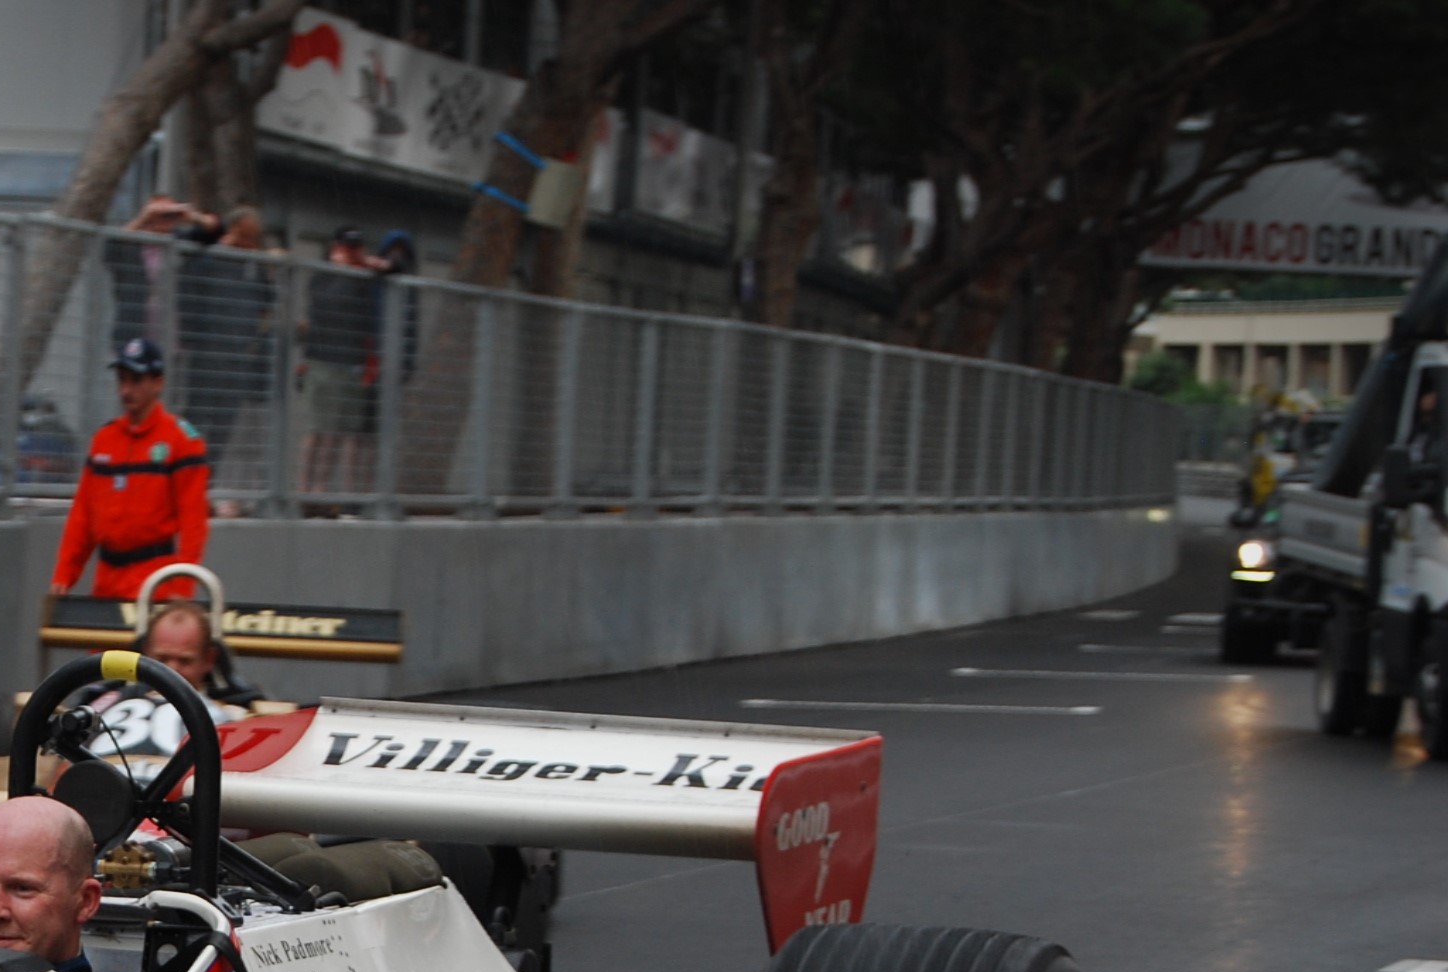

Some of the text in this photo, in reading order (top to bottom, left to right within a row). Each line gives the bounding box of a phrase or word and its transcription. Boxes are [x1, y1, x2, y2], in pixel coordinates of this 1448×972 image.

[775, 801, 831, 852] GOOD
[250, 937, 334, 968] Nick Padmore
